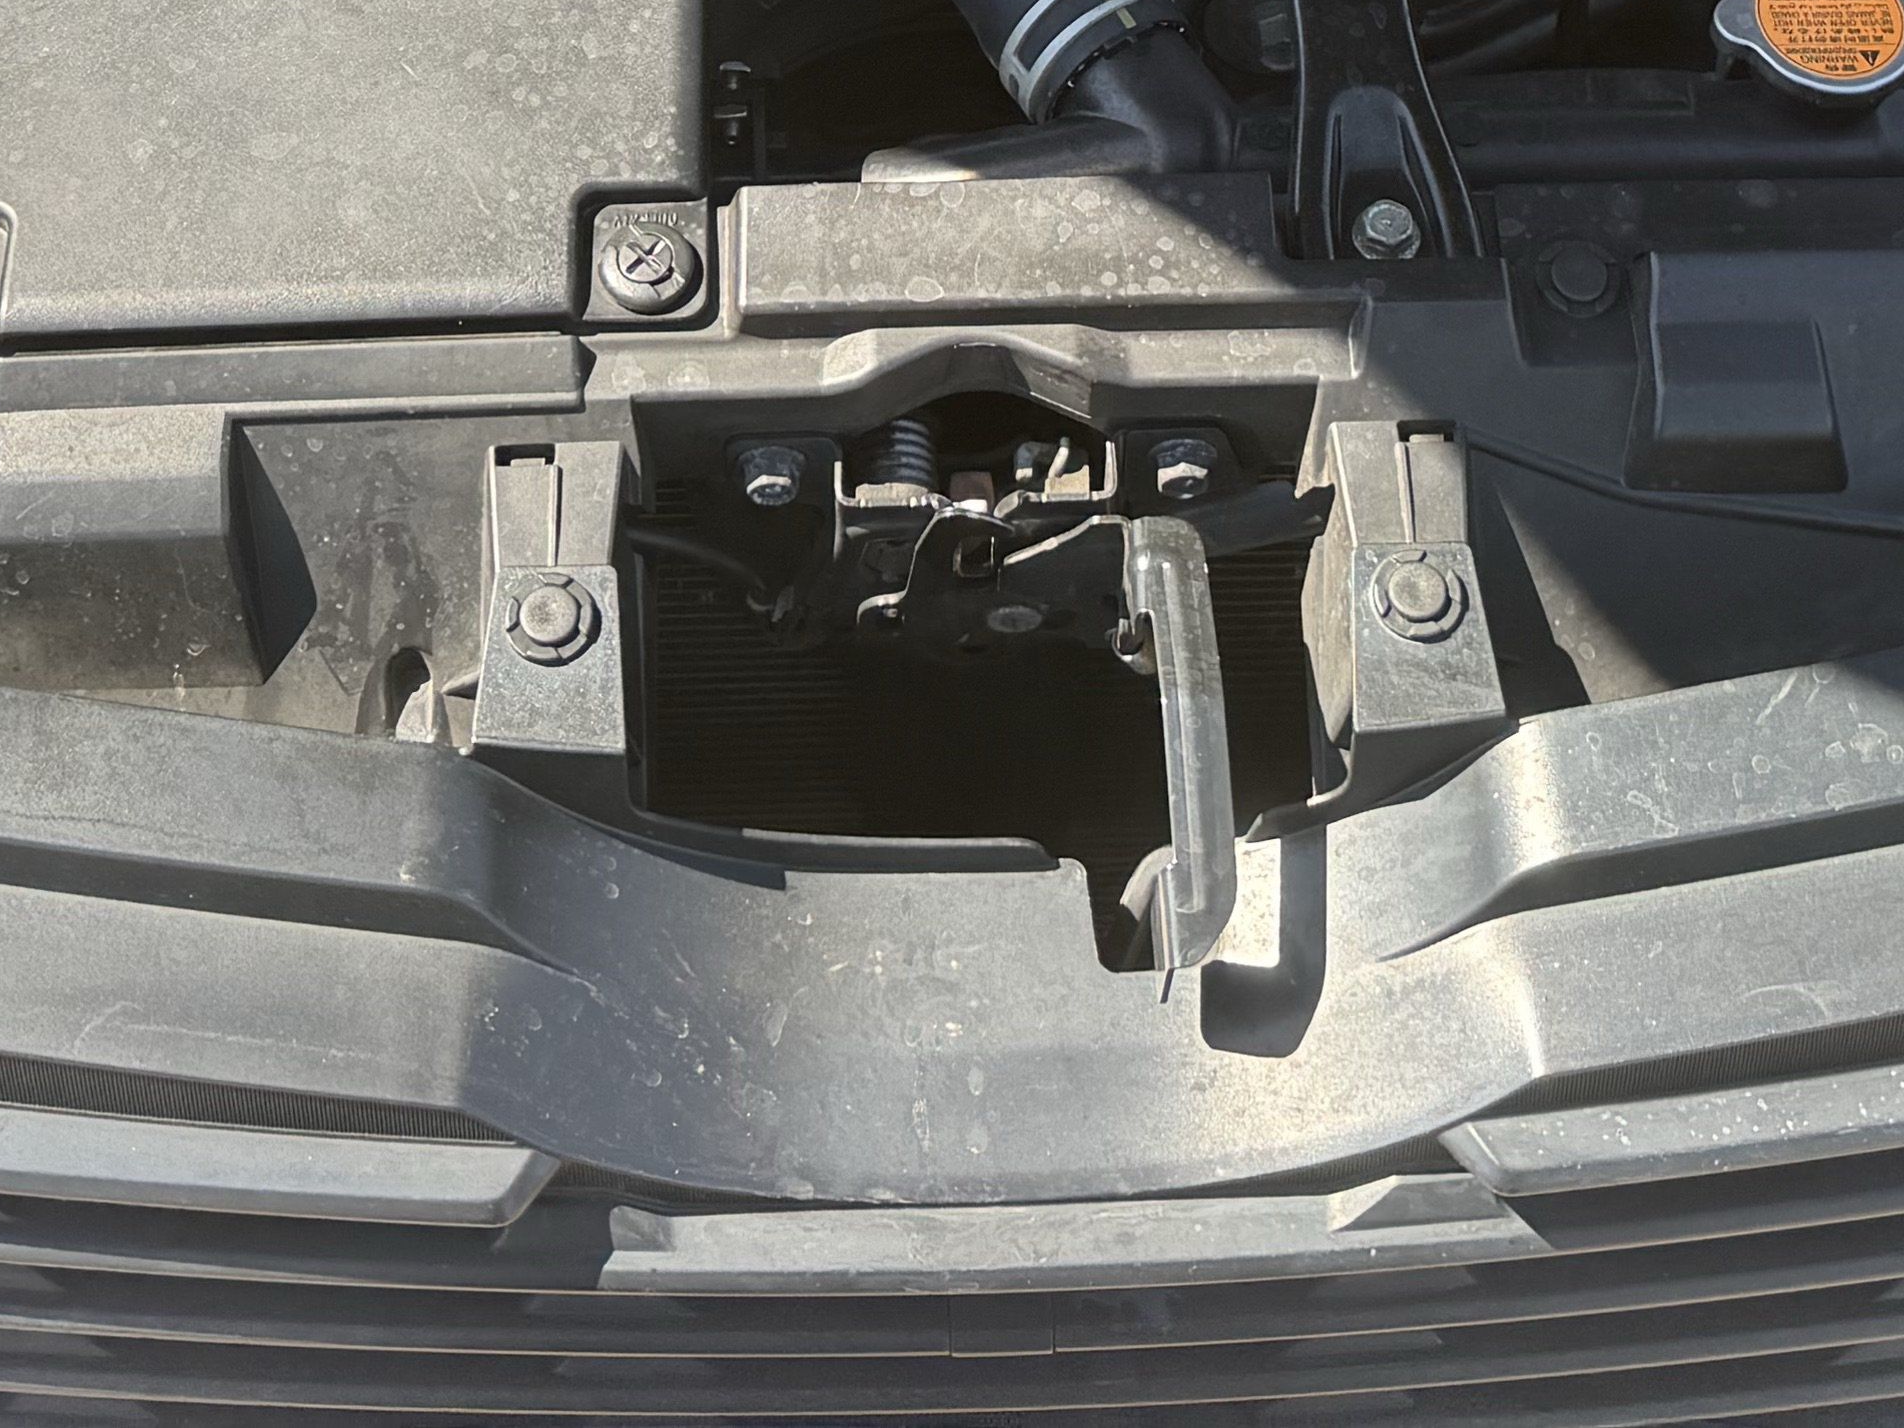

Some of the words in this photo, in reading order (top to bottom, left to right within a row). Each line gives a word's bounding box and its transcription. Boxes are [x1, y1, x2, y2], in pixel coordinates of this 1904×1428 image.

[1772, 18, 1793, 27] HOT
[1796, 18, 1827, 27] WHEN
[1829, 18, 1857, 27] OPEN
[1860, 18, 1893, 27] NEVER
[1799, 54, 1859, 64] WARNING
